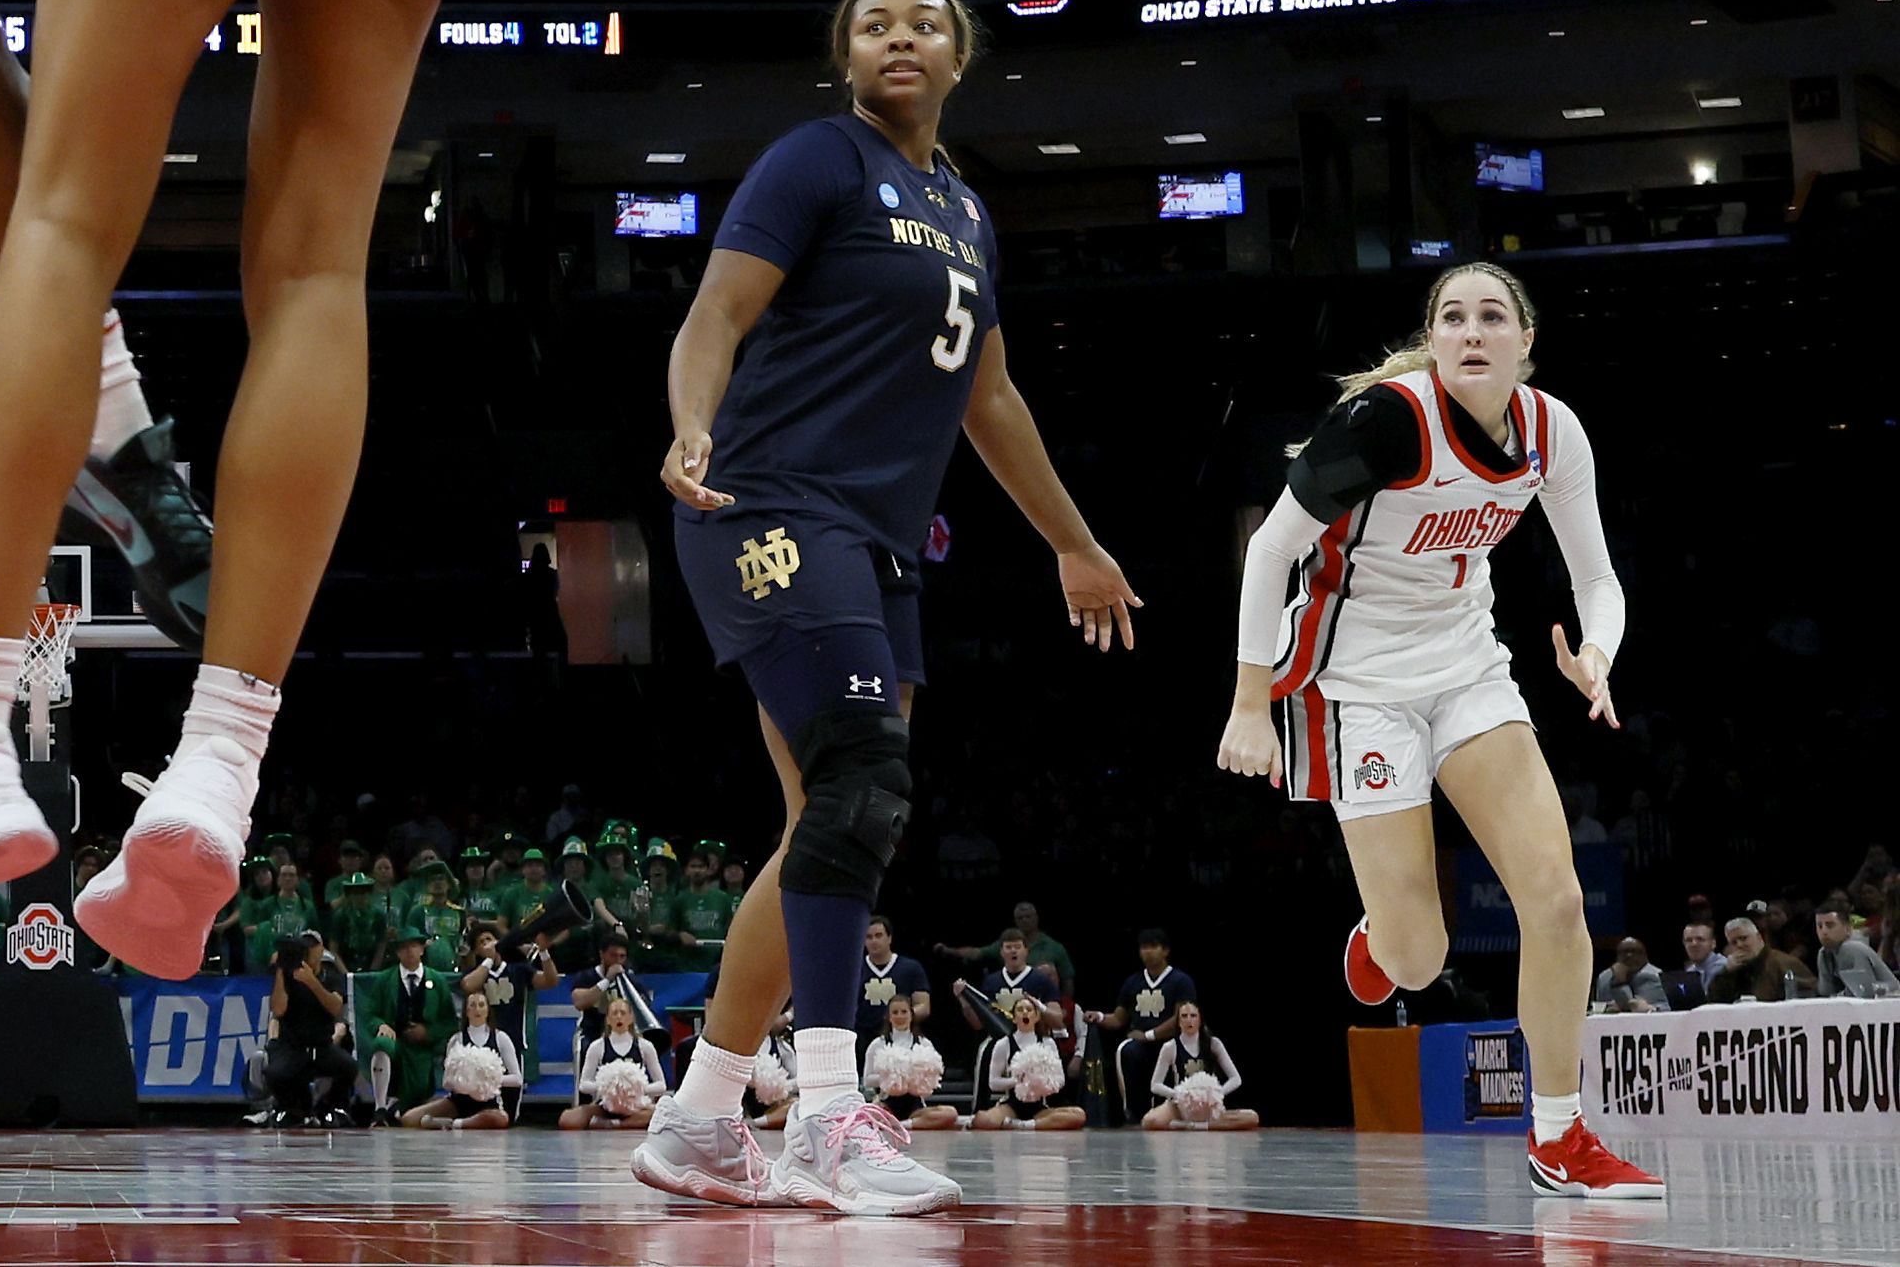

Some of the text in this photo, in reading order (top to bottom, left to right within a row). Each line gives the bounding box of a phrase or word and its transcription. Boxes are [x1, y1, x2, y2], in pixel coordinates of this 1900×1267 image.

[1141, 1, 1200, 23] OHIO
[543, 22, 598, 44] TOL 2
[889, 217, 956, 258] NOTRE
[930, 265, 980, 372] 5
[1450, 554, 1467, 589] 1
[1474, 1039, 1508, 1070] MARCH
[1600, 1034, 1667, 1114] FIRST
[1667, 1058, 1693, 1090] AND
[1697, 1025, 1809, 1114] SECOND
[1480, 1071, 1524, 1104] MADNESS
